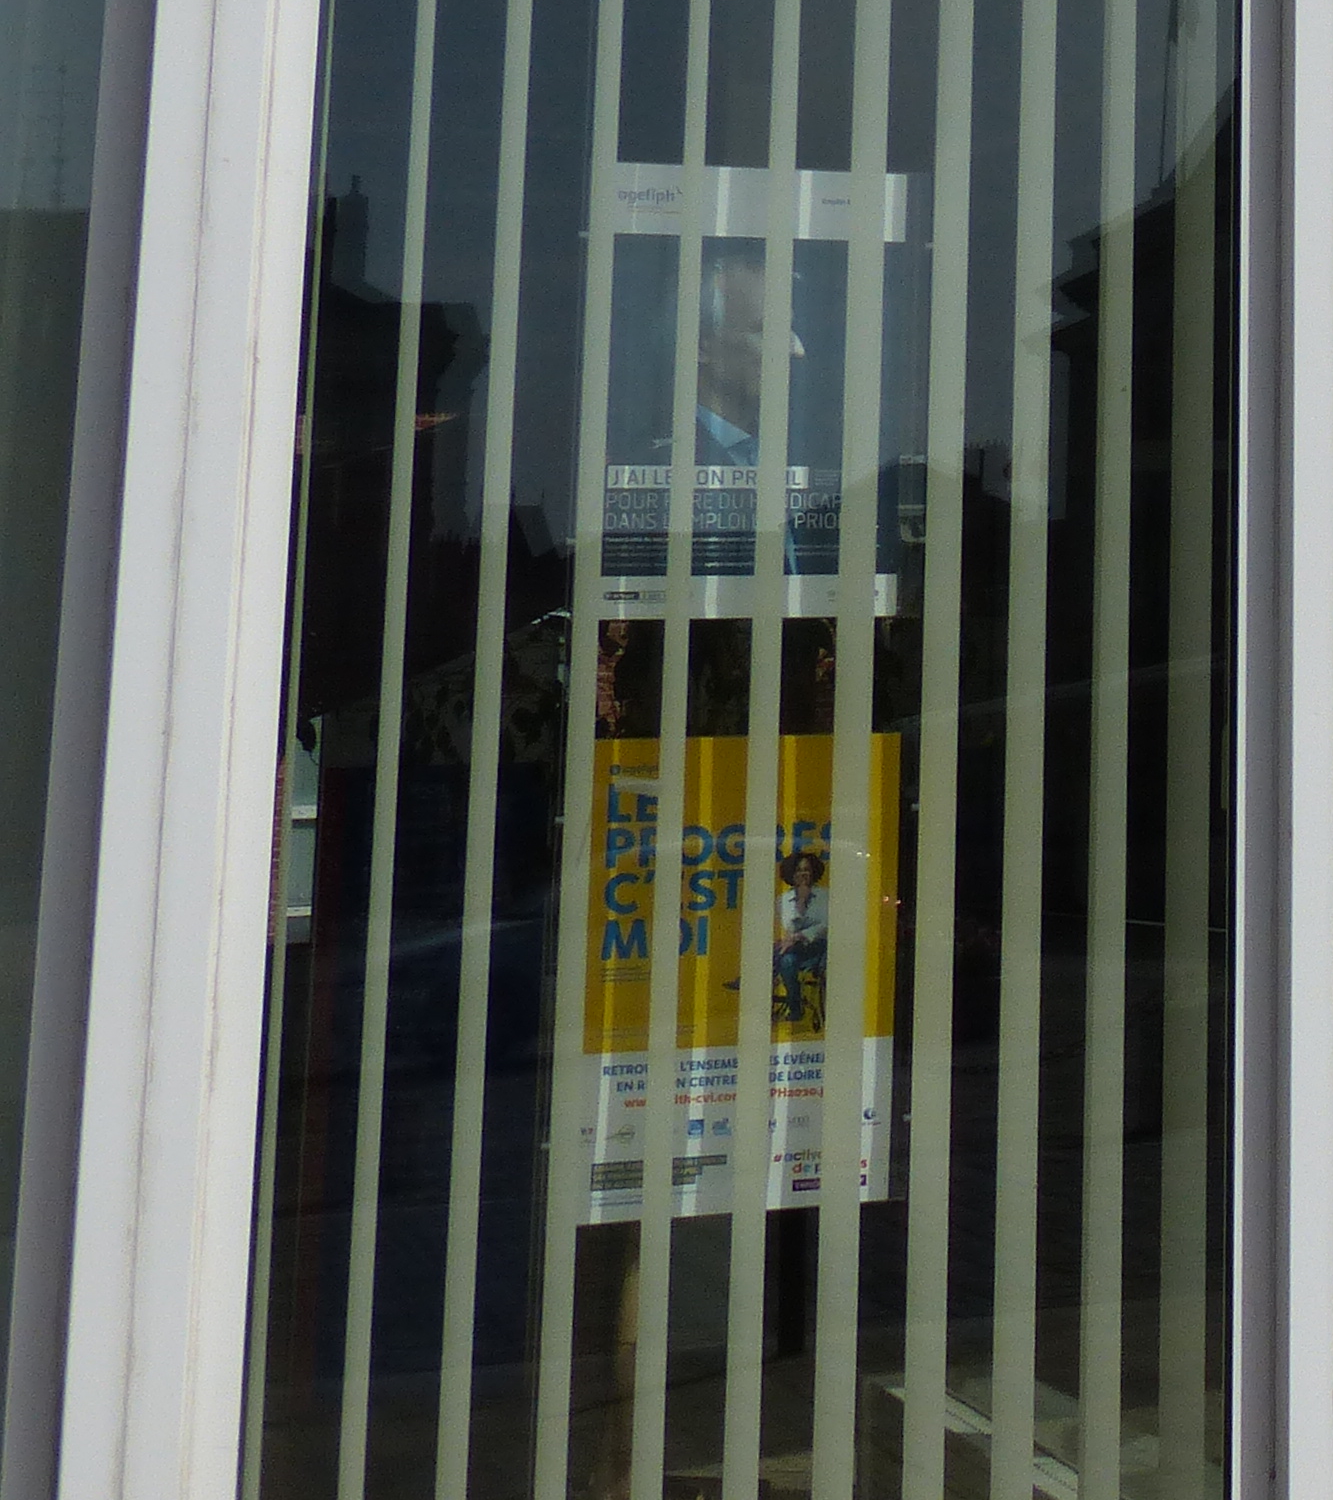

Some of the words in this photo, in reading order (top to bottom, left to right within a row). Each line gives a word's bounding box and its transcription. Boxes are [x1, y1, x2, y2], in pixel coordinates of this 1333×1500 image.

[653, 468, 672, 485] LE
[696, 469, 724, 485] ON
[732, 469, 801, 486] PRIL
[605, 492, 659, 510] POUR
[663, 492, 713, 510] FRE
[719, 492, 740, 510] DU
[750, 492, 842, 510] HDICAP
[604, 512, 657, 530] DANS
[662, 512, 746, 530] LMPLOI
[608, 783, 658, 823] LE
[604, 868, 744, 915] C'ST
[603, 1063, 648, 1076] RETRO
[787, 1068, 822, 1081] LOIRE
